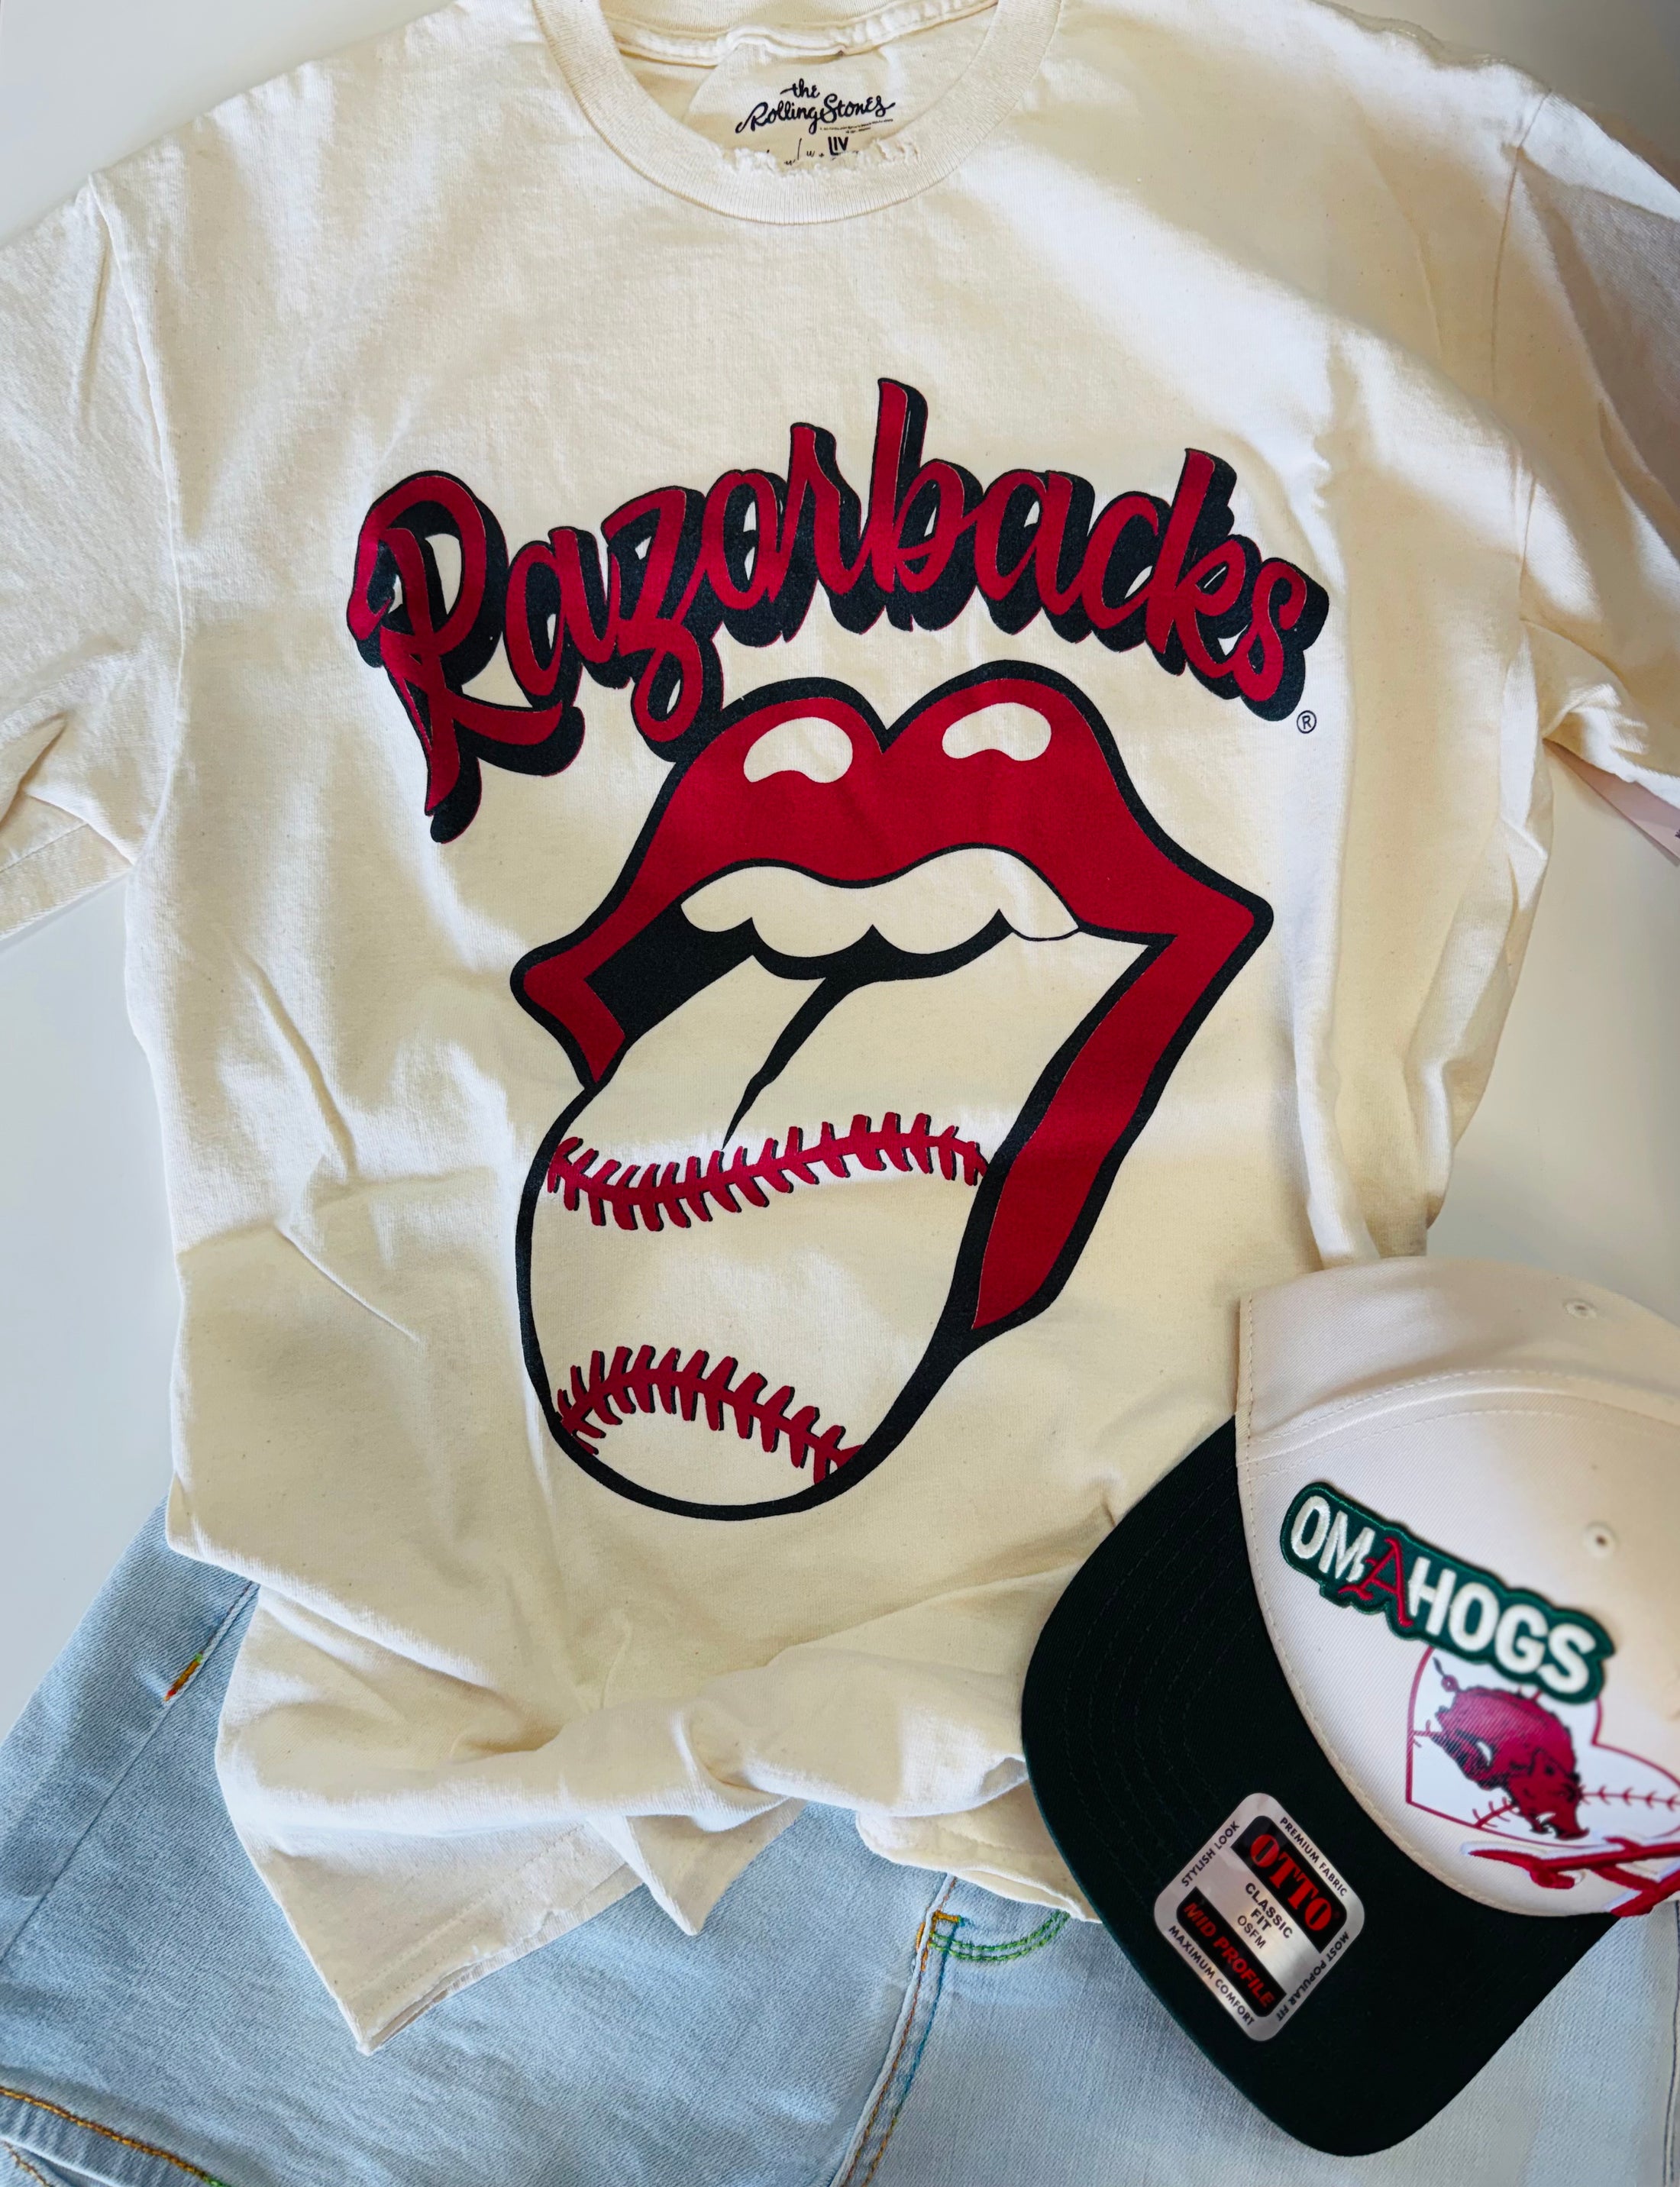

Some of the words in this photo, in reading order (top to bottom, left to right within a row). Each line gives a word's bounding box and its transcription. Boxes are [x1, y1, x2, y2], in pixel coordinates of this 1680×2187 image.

[735, 101, 819, 135] Rolling
[819, 92, 897, 124] Stones
[780, 78, 820, 99] the
[347, 377, 1329, 845] Razorbacks
[1291, 1495, 1596, 1694] OMAHOGS
[1181, 1848, 1216, 1887] STYLISH
[1214, 1820, 1240, 1851] LOOK
[1280, 1817, 1320, 1864] PREMIUM
[1319, 1861, 1348, 1898] FABRIC
[1245, 1882, 1294, 1939] CLASSIC
[1250, 1834, 1332, 1931] OTTO
[1236, 1914, 1267, 1950] OSFM
[1250, 1908, 1272, 1931] FIT
[1325, 1930, 1350, 1962] MOST
[1168, 1925, 1216, 1980] MAXIMUM
[1214, 1978, 1256, 2027] COMFORT
[1184, 1902, 1217, 1937] MID
[1213, 1937, 1276, 2008] PROFILE
[1288, 1959, 1327, 2007] POPULAR
[1276, 2005, 1291, 2022] FIT
